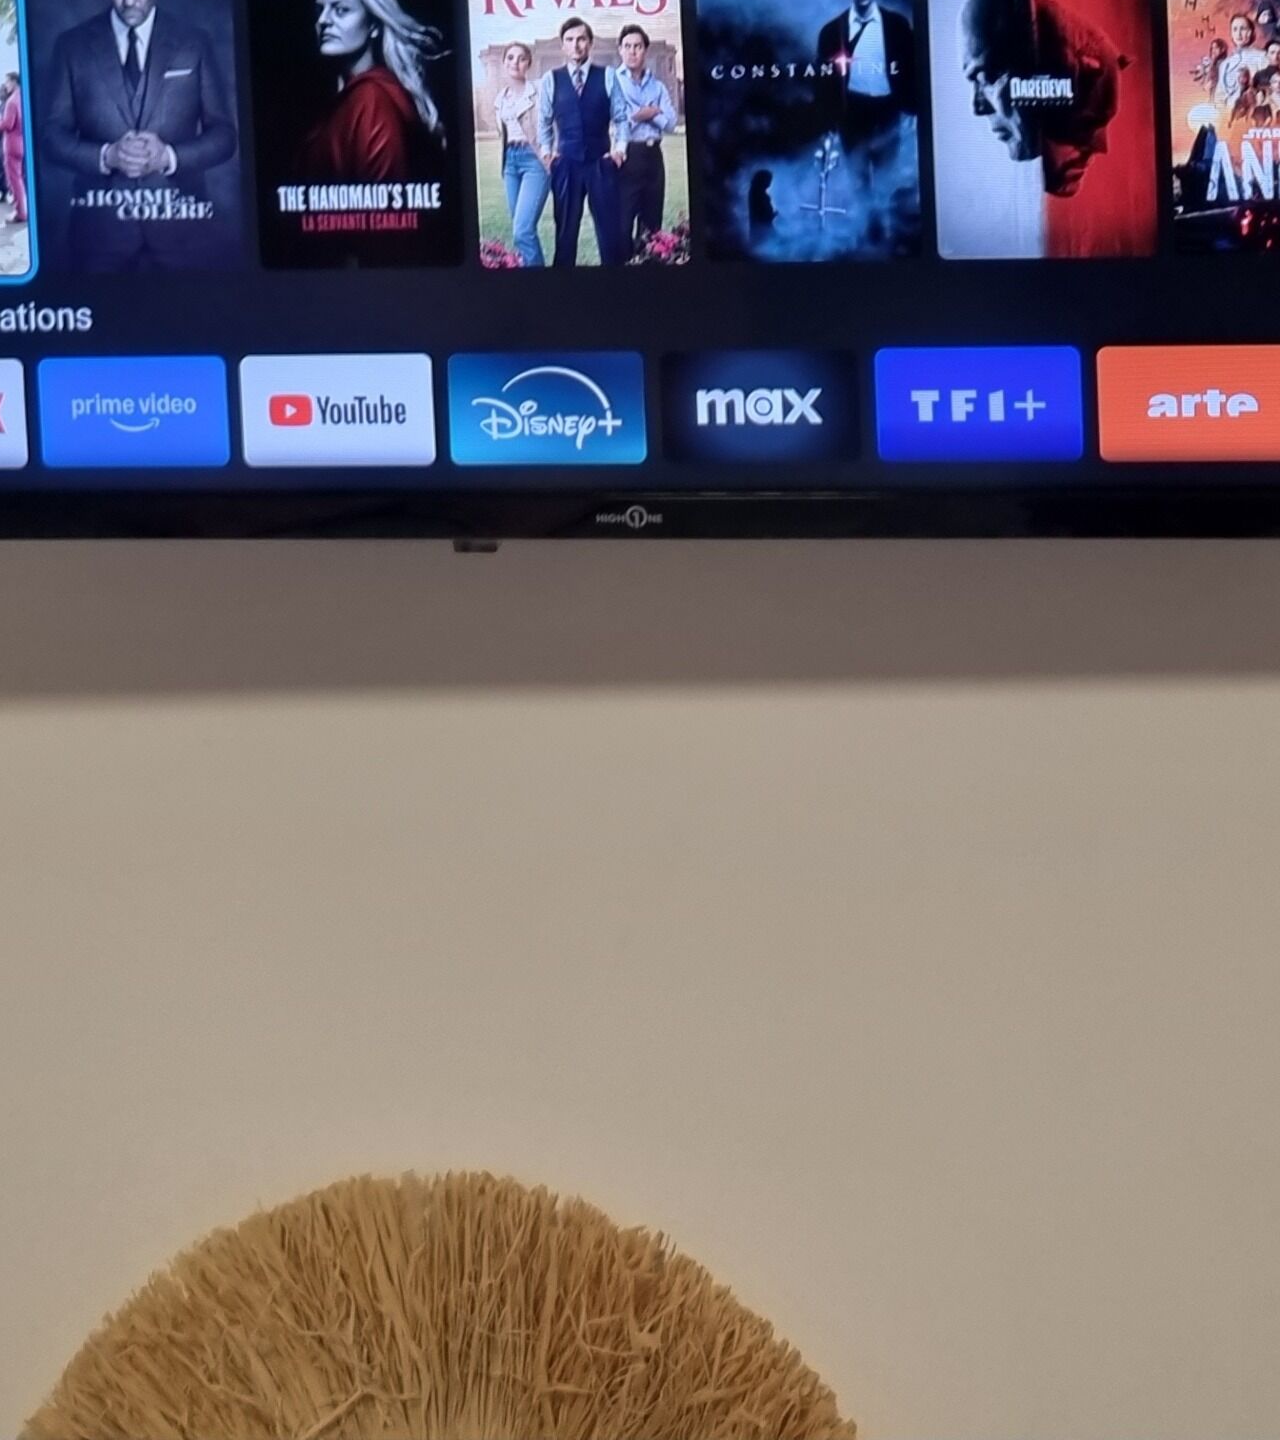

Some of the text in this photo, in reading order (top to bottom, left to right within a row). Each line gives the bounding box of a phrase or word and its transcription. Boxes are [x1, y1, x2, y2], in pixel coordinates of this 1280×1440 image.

[1010, 77, 1074, 98] DAREDEVIL
[277, 182, 441, 212] THE HANDMAID'S TALE
[71, 392, 196, 419] prime video
[316, 395, 406, 426] YouTube
[696, 388, 822, 425] max
[1146, 388, 1259, 418] arte
